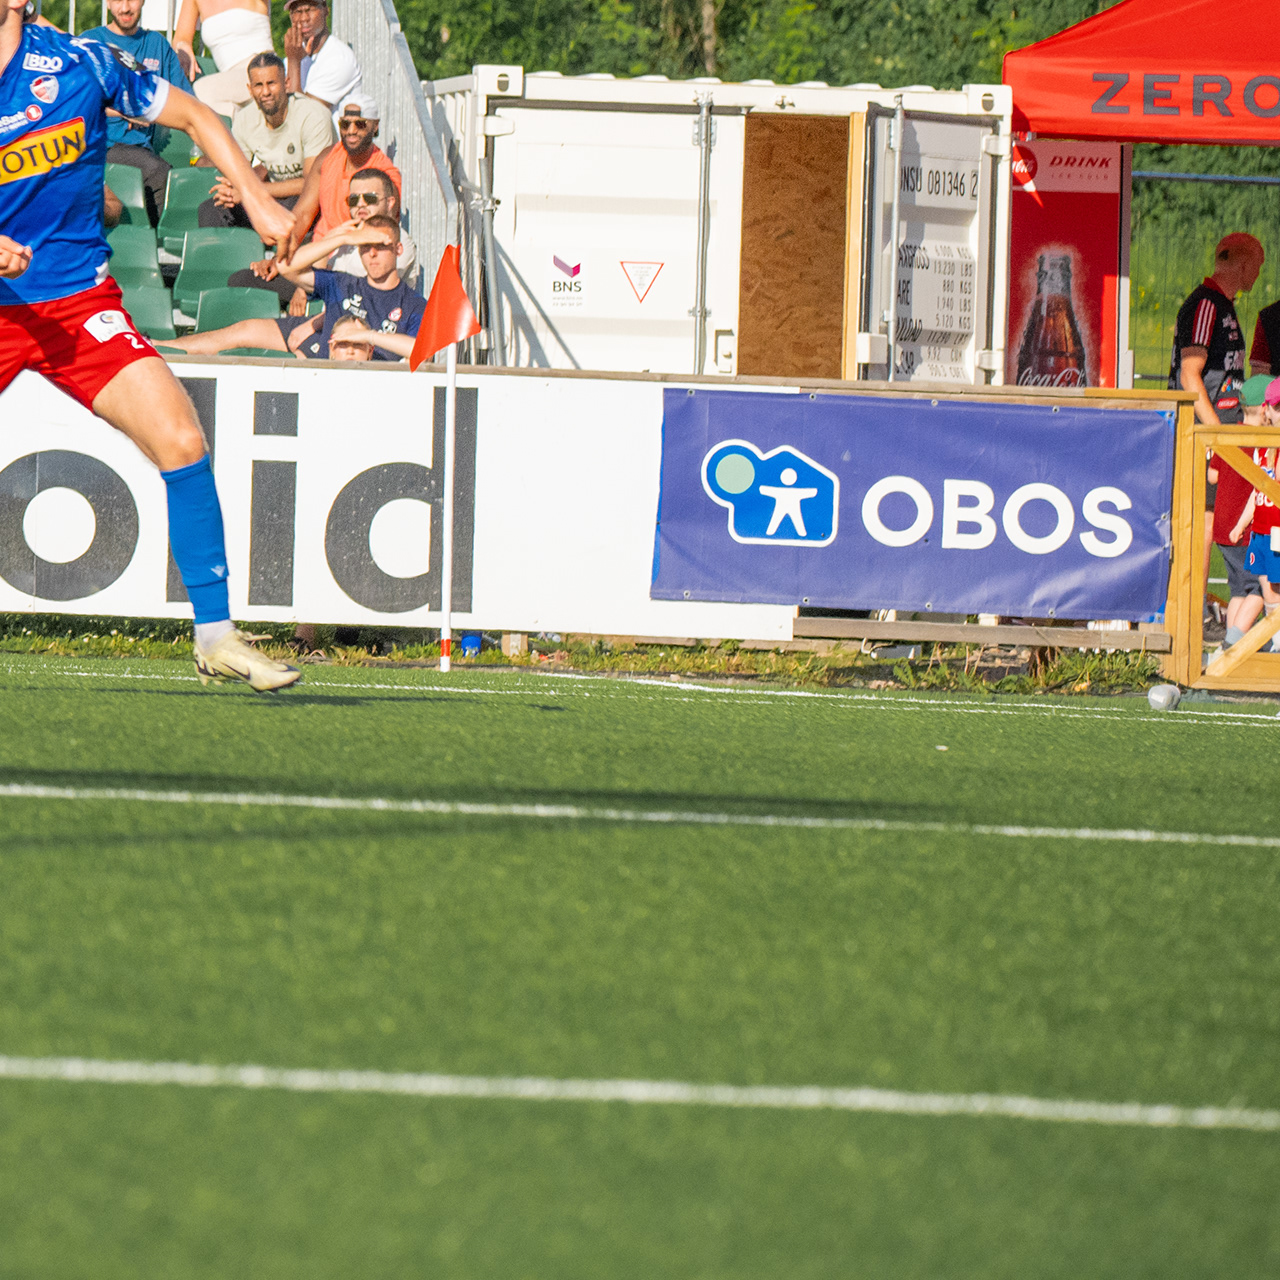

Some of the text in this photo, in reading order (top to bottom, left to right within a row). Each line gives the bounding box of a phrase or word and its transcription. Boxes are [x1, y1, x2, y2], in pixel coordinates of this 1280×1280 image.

[1091, 72, 1280, 119] ZERO
[1049, 155, 1112, 168] DRINK
[927, 169, 965, 196] 081346
[960, 262, 973, 277] LBS
[552, 281, 582, 292] BNS
[942, 279, 955, 293] 880
[959, 280, 972, 295] KGS
[959, 298, 972, 312] LBS
[959, 315, 971, 329] KGS
[861, 476, 1133, 558] OBOS
